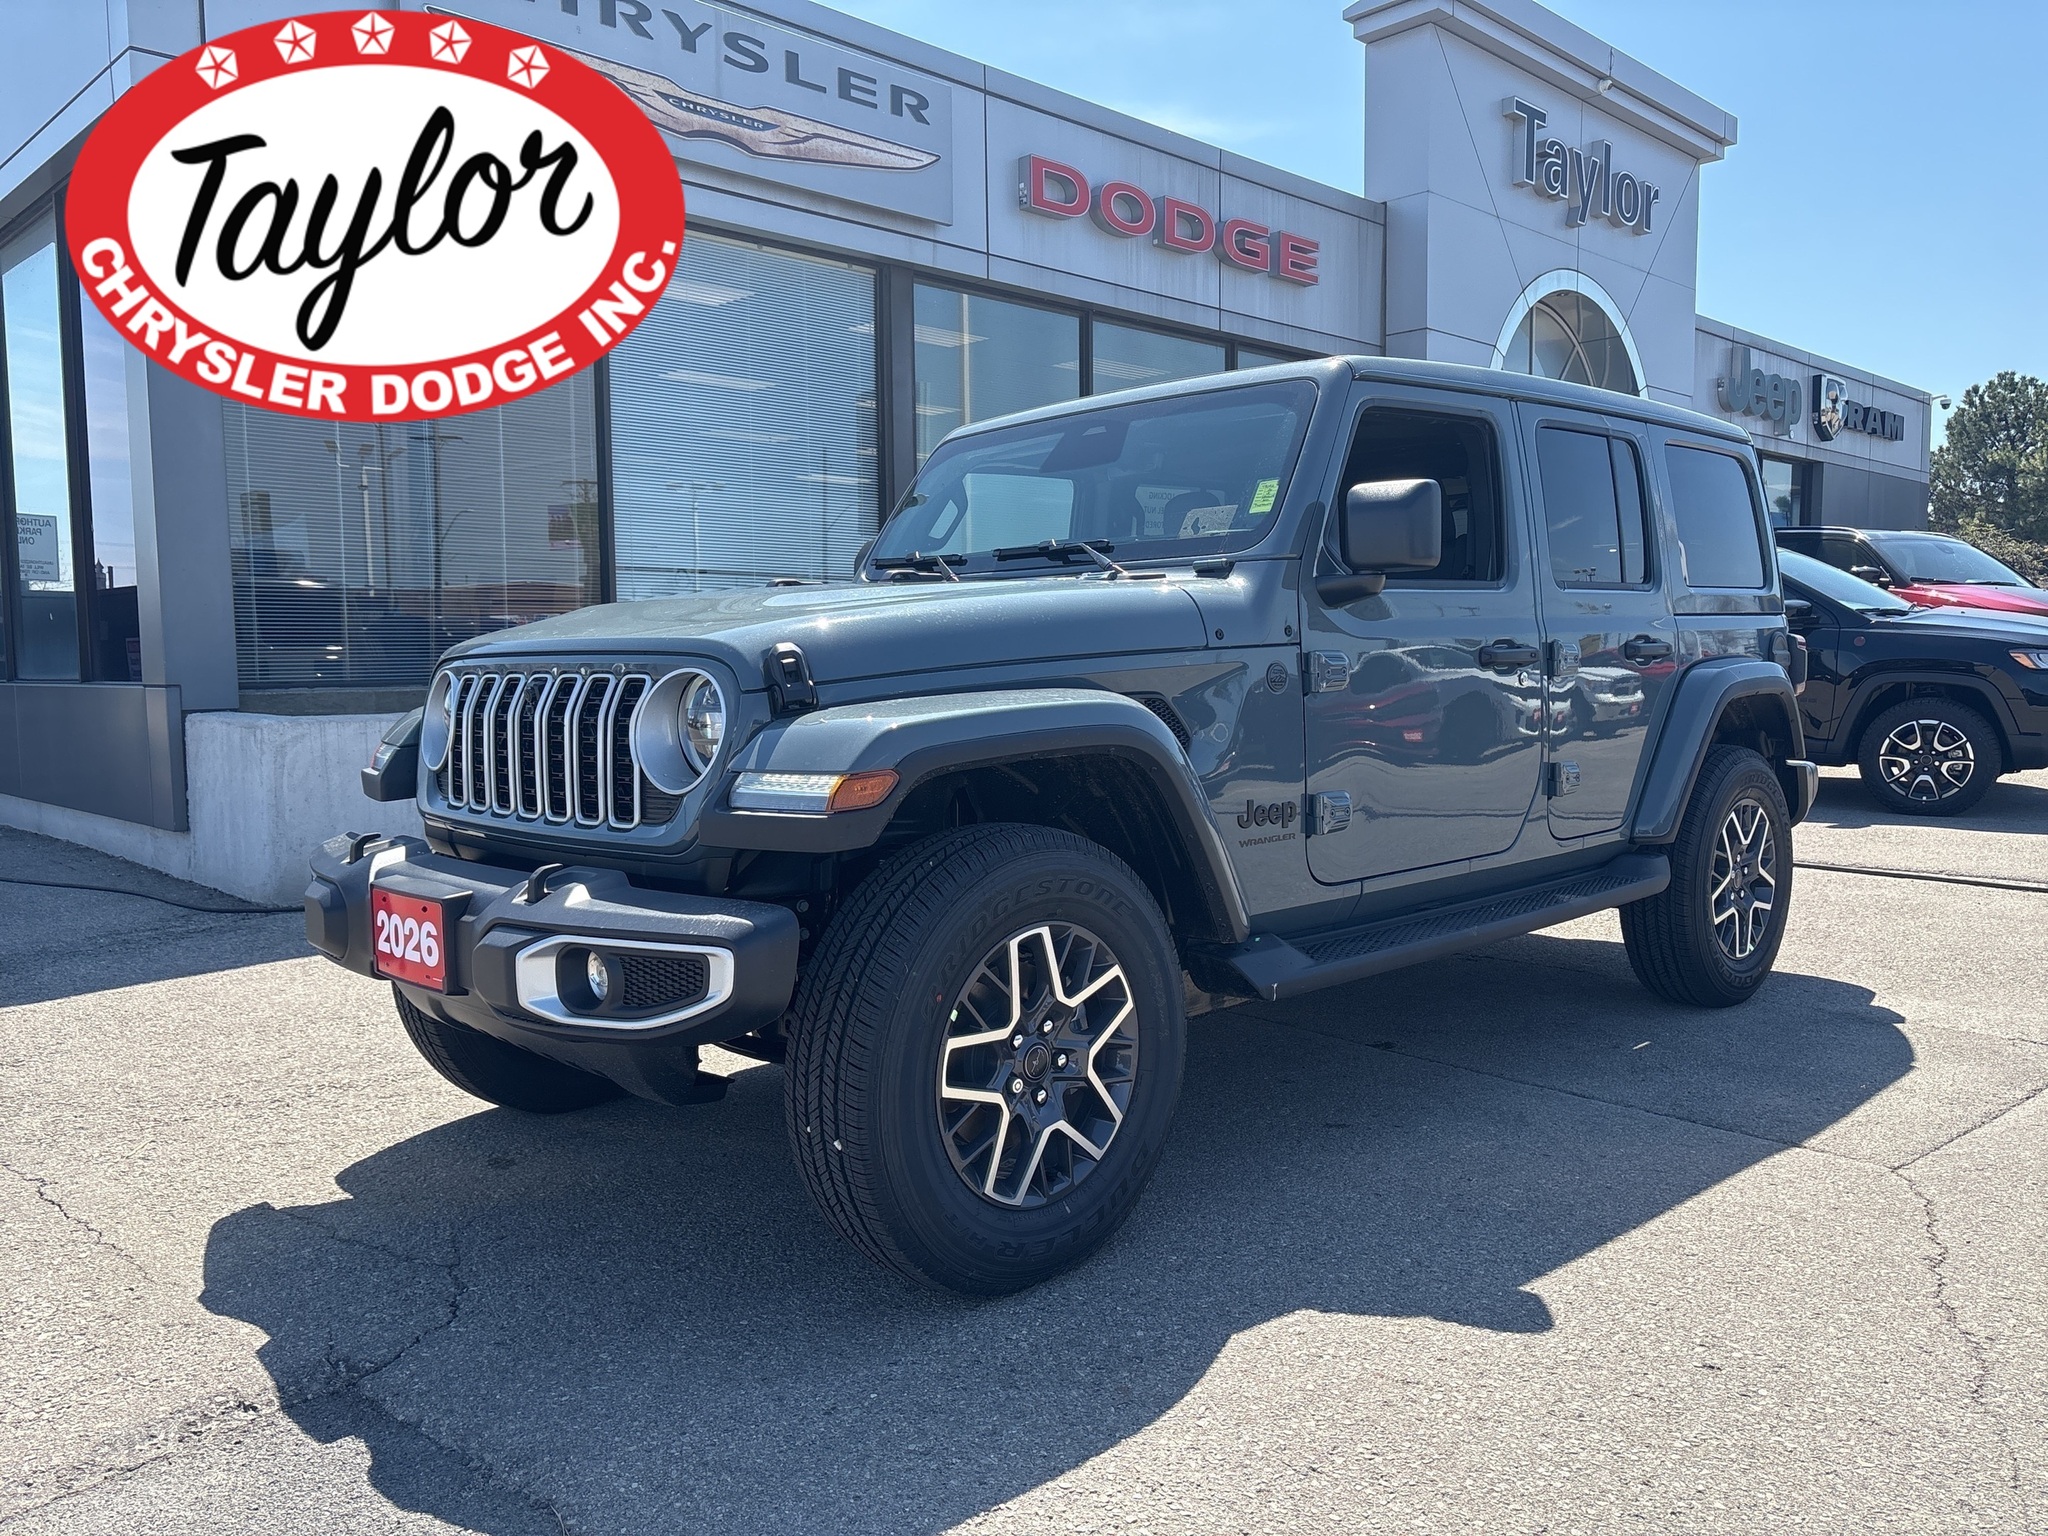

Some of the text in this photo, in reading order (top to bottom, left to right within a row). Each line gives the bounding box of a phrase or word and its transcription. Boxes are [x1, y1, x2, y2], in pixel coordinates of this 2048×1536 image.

[525, 0, 930, 126] RYSLER
[668, 98, 764, 129] CHRYSLER
[1503, 96, 1661, 235] Taylor
[1018, 154, 1320, 287] DODGE
[1718, 346, 1905, 441] Jeep RAM
[1236, 798, 1297, 829] Jeep
[1238, 832, 1296, 848] WRANGLER
[376, 909, 439, 967] 2026
